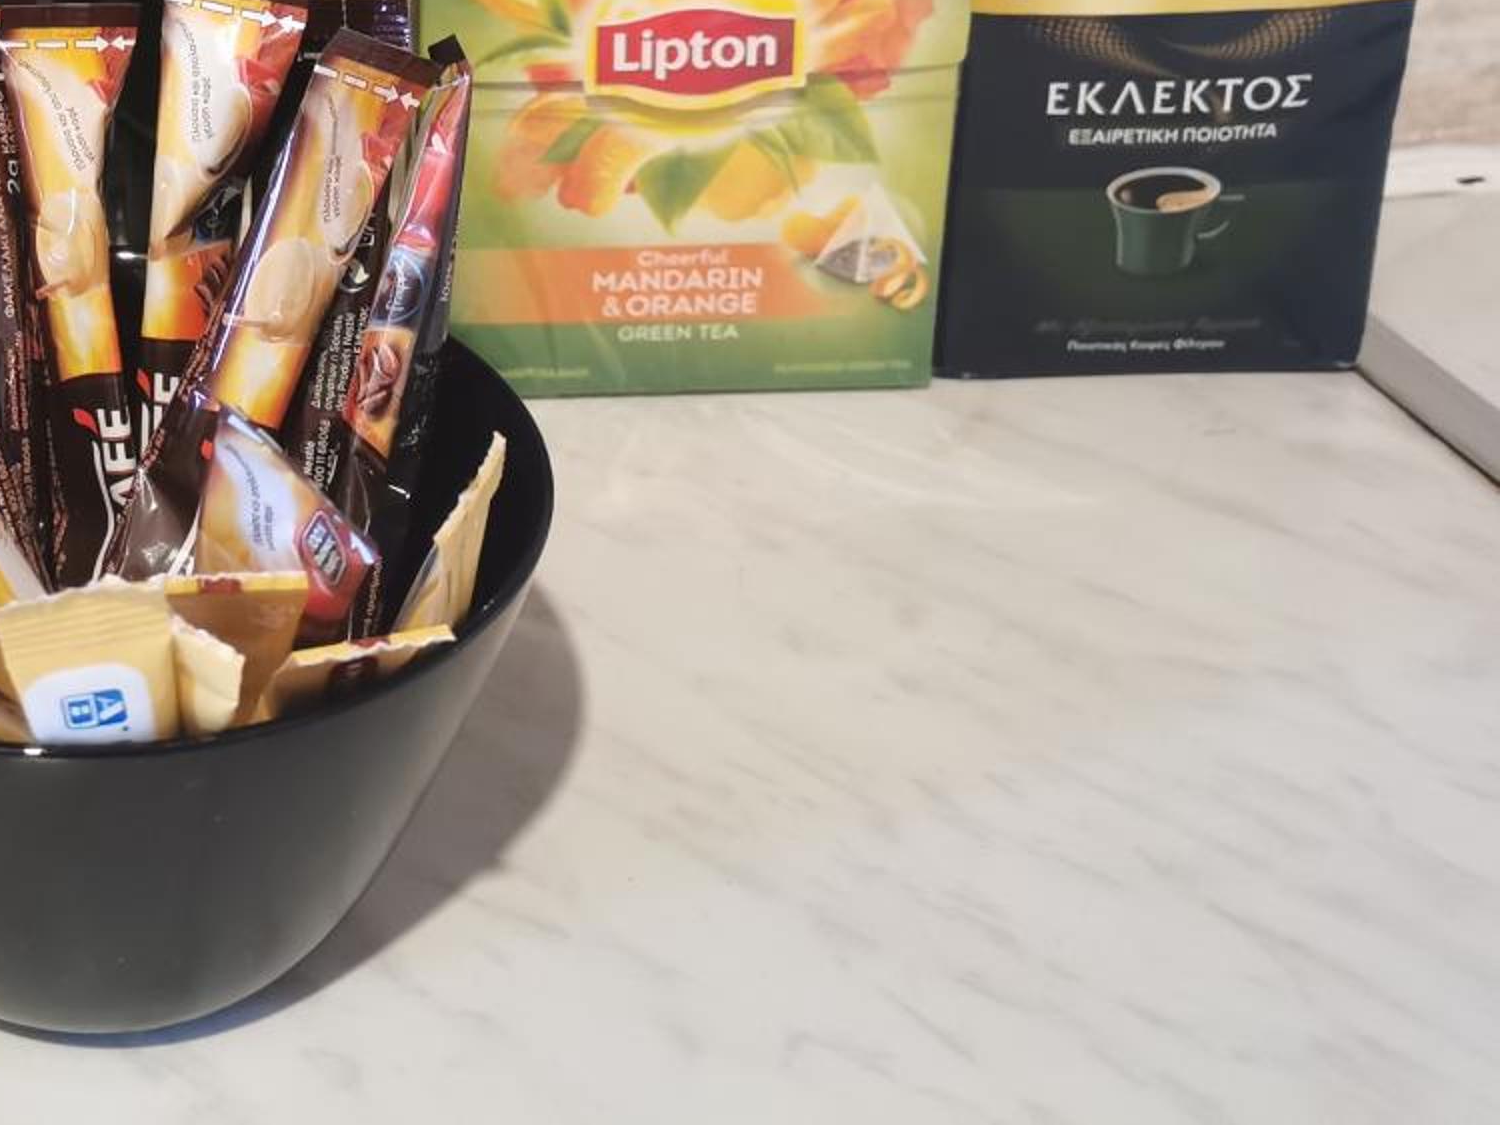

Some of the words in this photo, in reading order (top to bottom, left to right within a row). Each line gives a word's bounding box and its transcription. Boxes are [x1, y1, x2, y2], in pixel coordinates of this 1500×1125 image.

[612, 25, 778, 80] Lipton
[1046, 73, 1313, 117] ΕΚΛΕΚΤΟΣ
[1069, 126, 1179, 146] ΕΞΑΙΡΕΤΙΚΗ
[1181, 121, 1278, 143] ΠΟΙΟΤΗΤΑ
[636, 249, 729, 267] Cheerful
[592, 267, 763, 293] MANDARIN
[601, 295, 621, 317] &
[626, 292, 757, 316] ORANGE
[617, 325, 692, 342] GREEN
[699, 323, 739, 340] TEA
